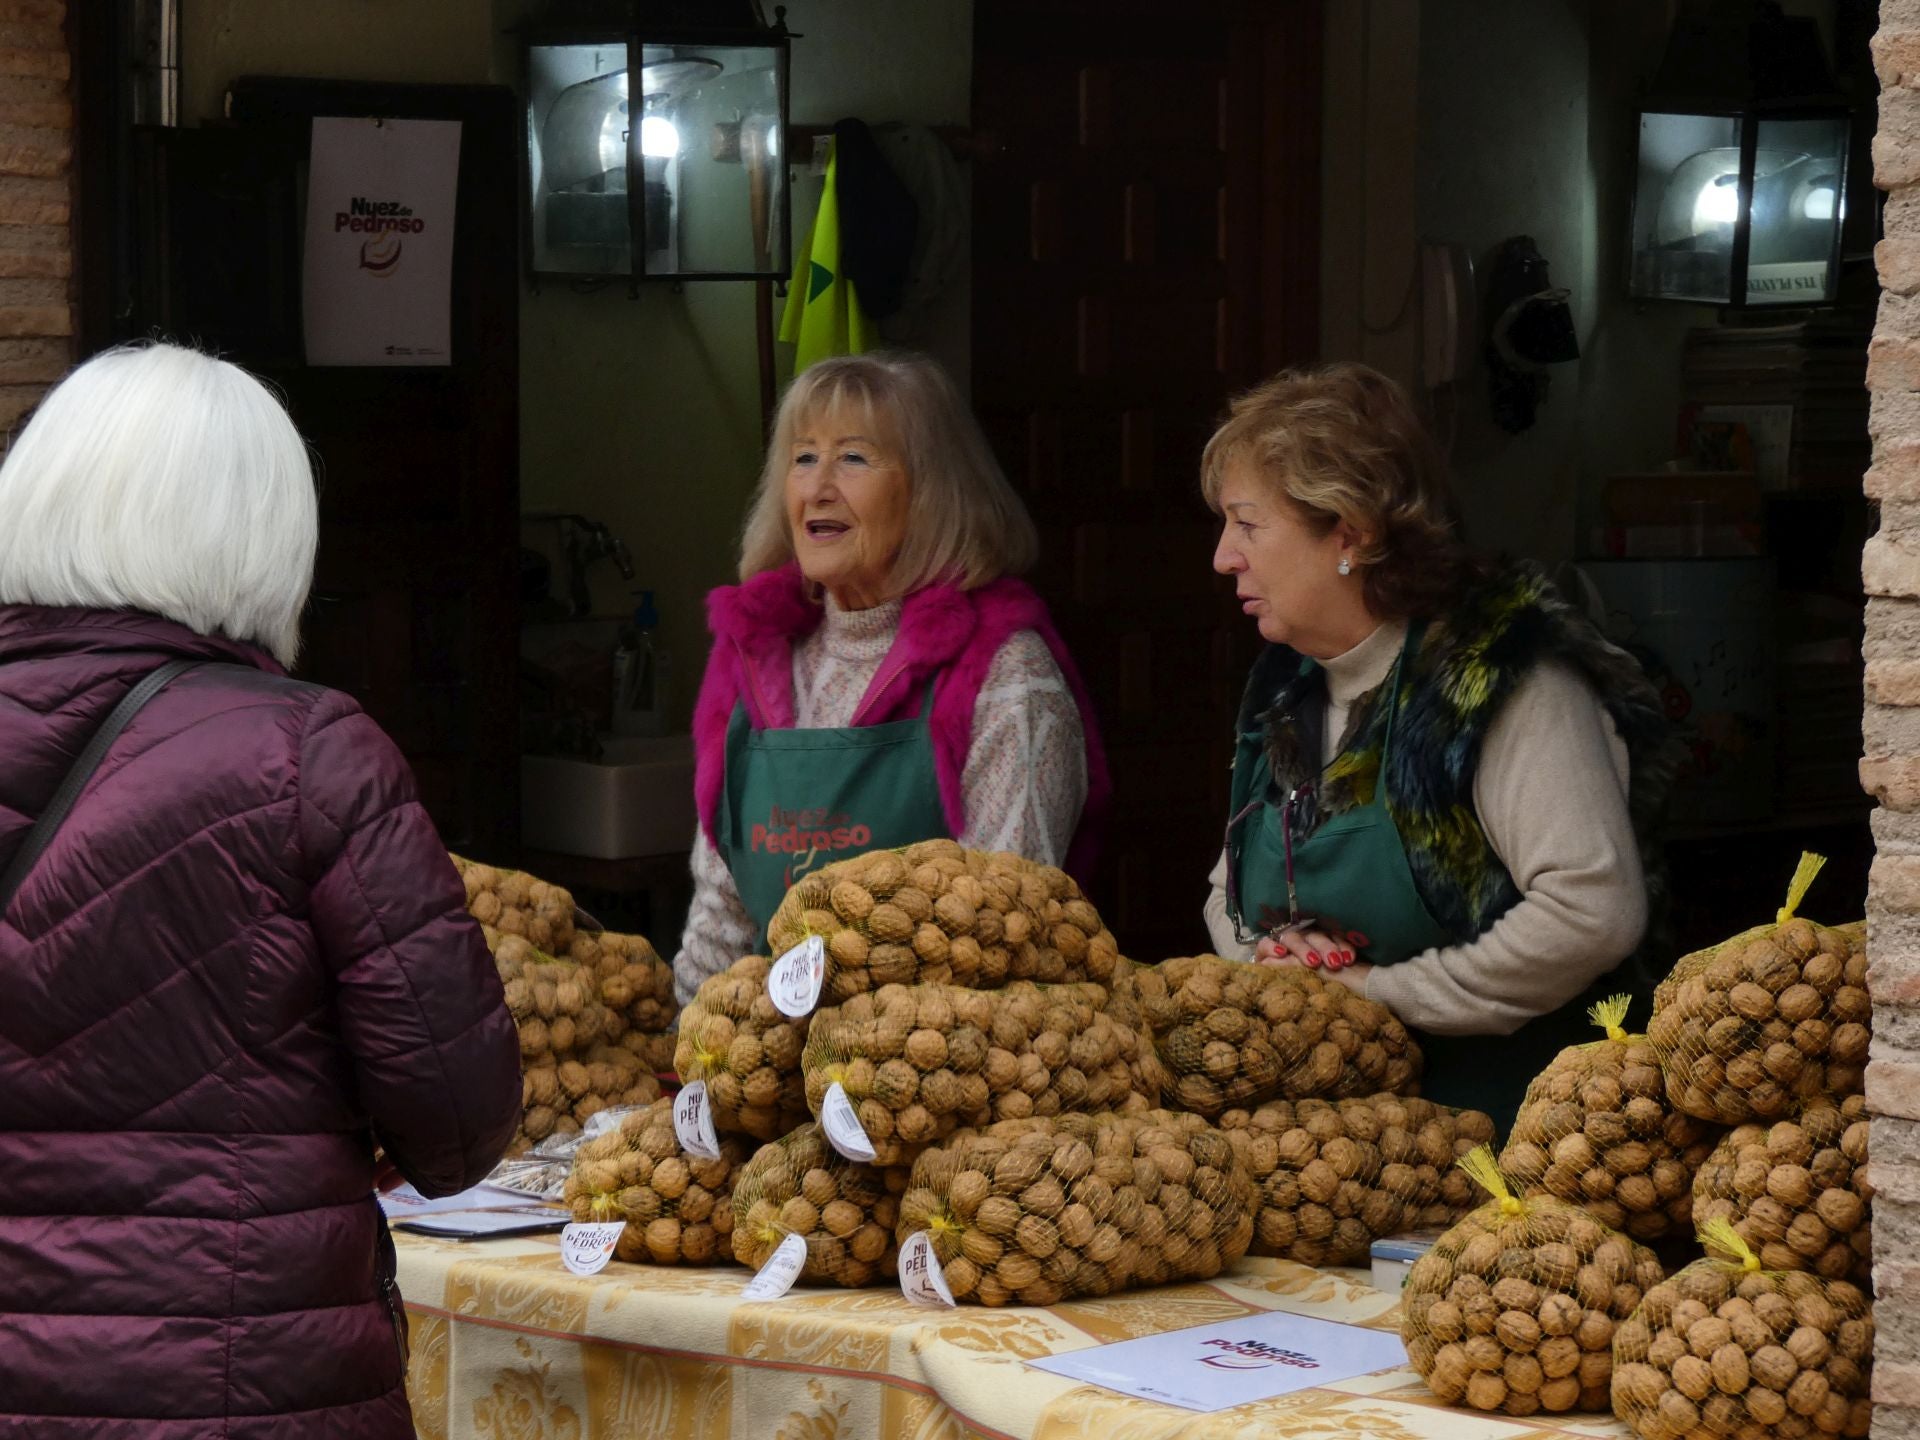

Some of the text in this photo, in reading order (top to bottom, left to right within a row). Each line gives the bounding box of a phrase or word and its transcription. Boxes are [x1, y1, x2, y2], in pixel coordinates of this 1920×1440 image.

[351, 197, 400, 216] Nuez
[335, 212, 425, 233] Pedroso
[751, 823, 872, 853] Pedroso
[1200, 1339, 1320, 1369] Pedroso
[1236, 1340, 1307, 1359] Nuez
